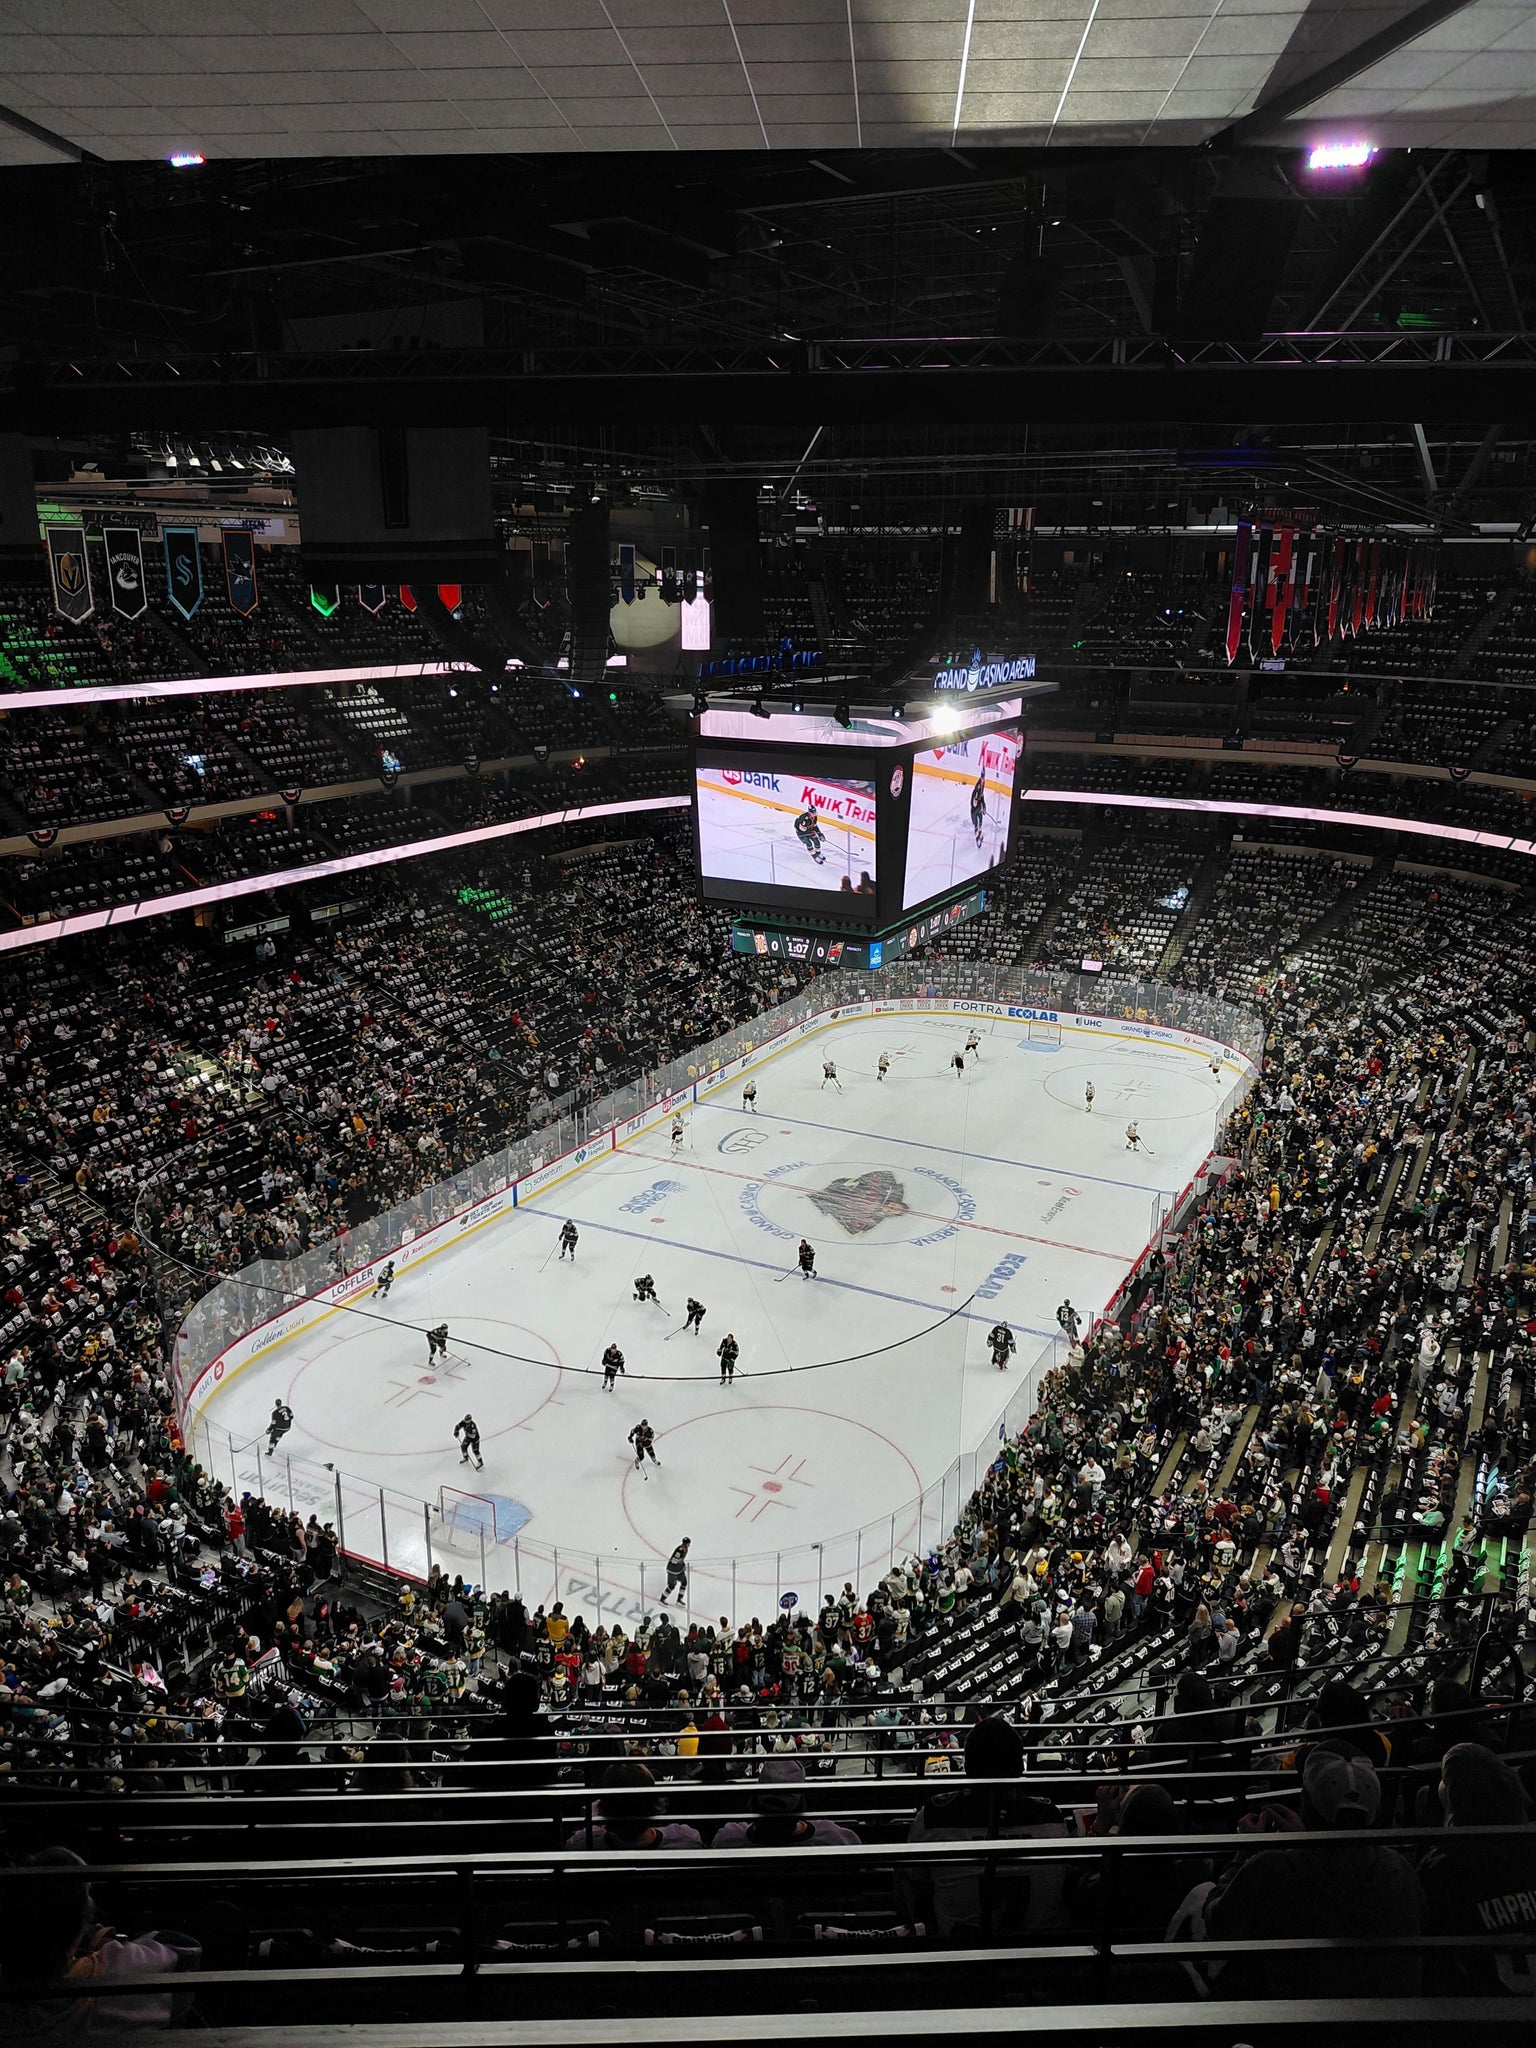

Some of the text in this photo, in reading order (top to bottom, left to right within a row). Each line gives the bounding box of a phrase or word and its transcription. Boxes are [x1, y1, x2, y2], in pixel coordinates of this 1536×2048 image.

[110, 553, 140, 565] VANCOUVER
[934, 658, 1036, 691] GRAND CASINO ARENA
[744, 771, 781, 792] bank
[771, 941, 778, 951] 0
[787, 942, 809, 954] 1:07
[817, 947, 824, 957] 0
[953, 1001, 1002, 1015] FORTRA
[1008, 1007, 1058, 1022] ECOLAB
[923, 1020, 986, 1033] FORTRA
[1083, 1019, 1103, 1028] UHC
[1121, 1025, 1173, 1039] GRAND CASINO
[672, 1091, 688, 1107] bank
[533, 1164, 563, 1186] solventum
[762, 1161, 810, 1179] ARENA
[913, 1166, 977, 1221] GRAND CASINO
[750, 1214, 796, 1240] GRAND
[909, 1225, 960, 1247] ARENA
[331, 1268, 374, 1298] LOFFLER
[975, 1253, 1028, 1300] ECOLAB
[1060, 1311, 1069, 1321] 13
[251, 1318, 305, 1354] Golden LIGHT
[197, 1375, 212, 1398] BMO
[1222, 1553, 1233, 1565] 97
[848, 1605, 859, 1618] 14
[825, 1617, 839, 1628] 97
[859, 1625, 872, 1638] 37
[537, 1653, 550, 1664] 43
[784, 1660, 796, 1671] 90
[224, 1672, 239, 1685] 14
[427, 1683, 438, 1694] 12
[803, 1681, 815, 1693] 12
[553, 1690, 567, 1701] 12
[1477, 1890, 1536, 1930] KAPRI
